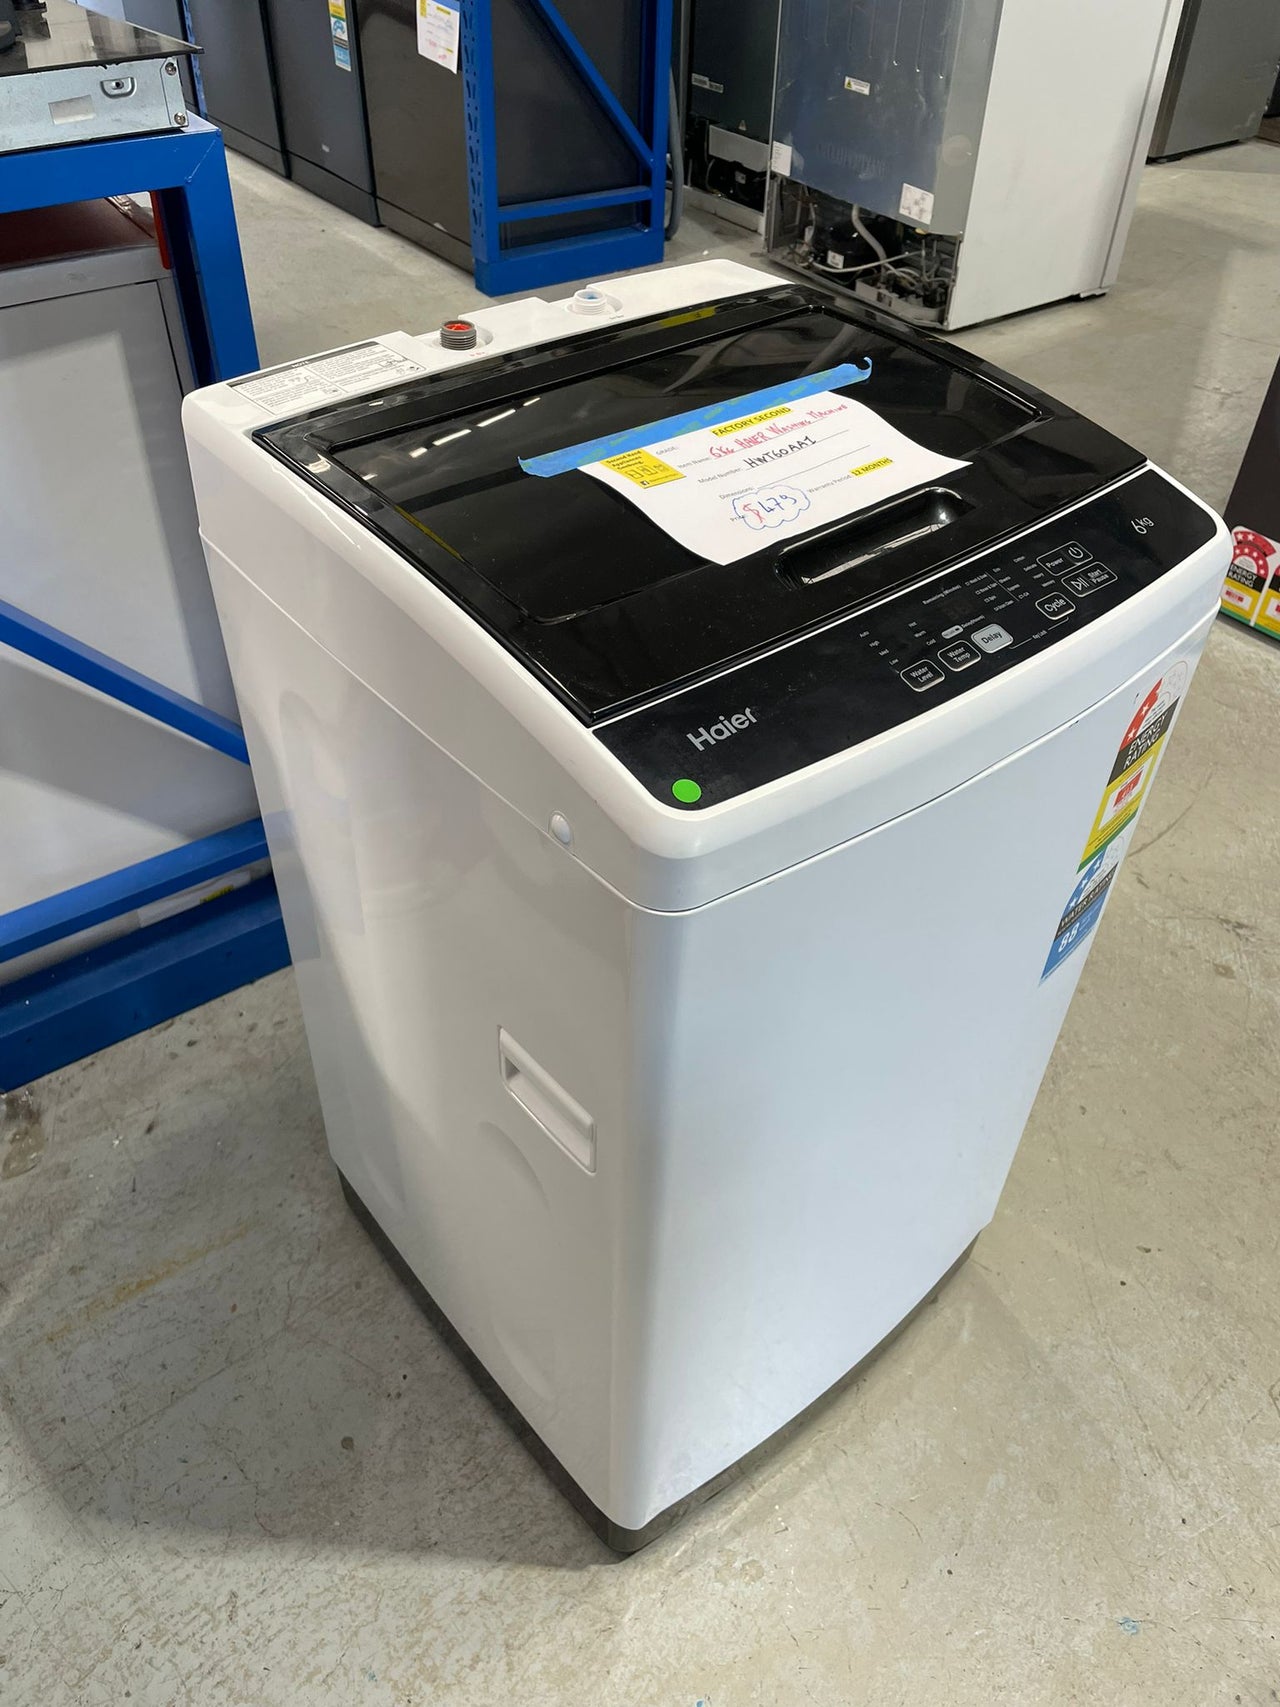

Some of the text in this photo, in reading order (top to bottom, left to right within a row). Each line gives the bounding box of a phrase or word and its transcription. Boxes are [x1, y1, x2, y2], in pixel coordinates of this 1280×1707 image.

[712, 406, 792, 436] FACTORY SECOND
[697, 475, 718, 484] Model
[808, 480, 834, 494] Warranty
[851, 469, 862, 477] 12
[862, 458, 893, 473] MONTHS
[1130, 516, 1155, 535] 6kg
[1045, 557, 1064, 568] Power
[1087, 568, 1102, 579] Start
[1092, 573, 1110, 584] Pause
[1230, 564, 1258, 581] ENERGY
[1228, 572, 1254, 588] RATING
[1044, 598, 1067, 612] Cycle
[980, 631, 1003, 644] Delay
[946, 646, 966, 658] Water
[954, 652, 971, 664] Temp
[910, 666, 929, 678] Water
[918, 672, 934, 683] Level
[686, 706, 758, 752] Haier
[1128, 711, 1168, 754] ENERGY
[1122, 727, 1161, 770] RATING
[1058, 922, 1080, 953] 88
